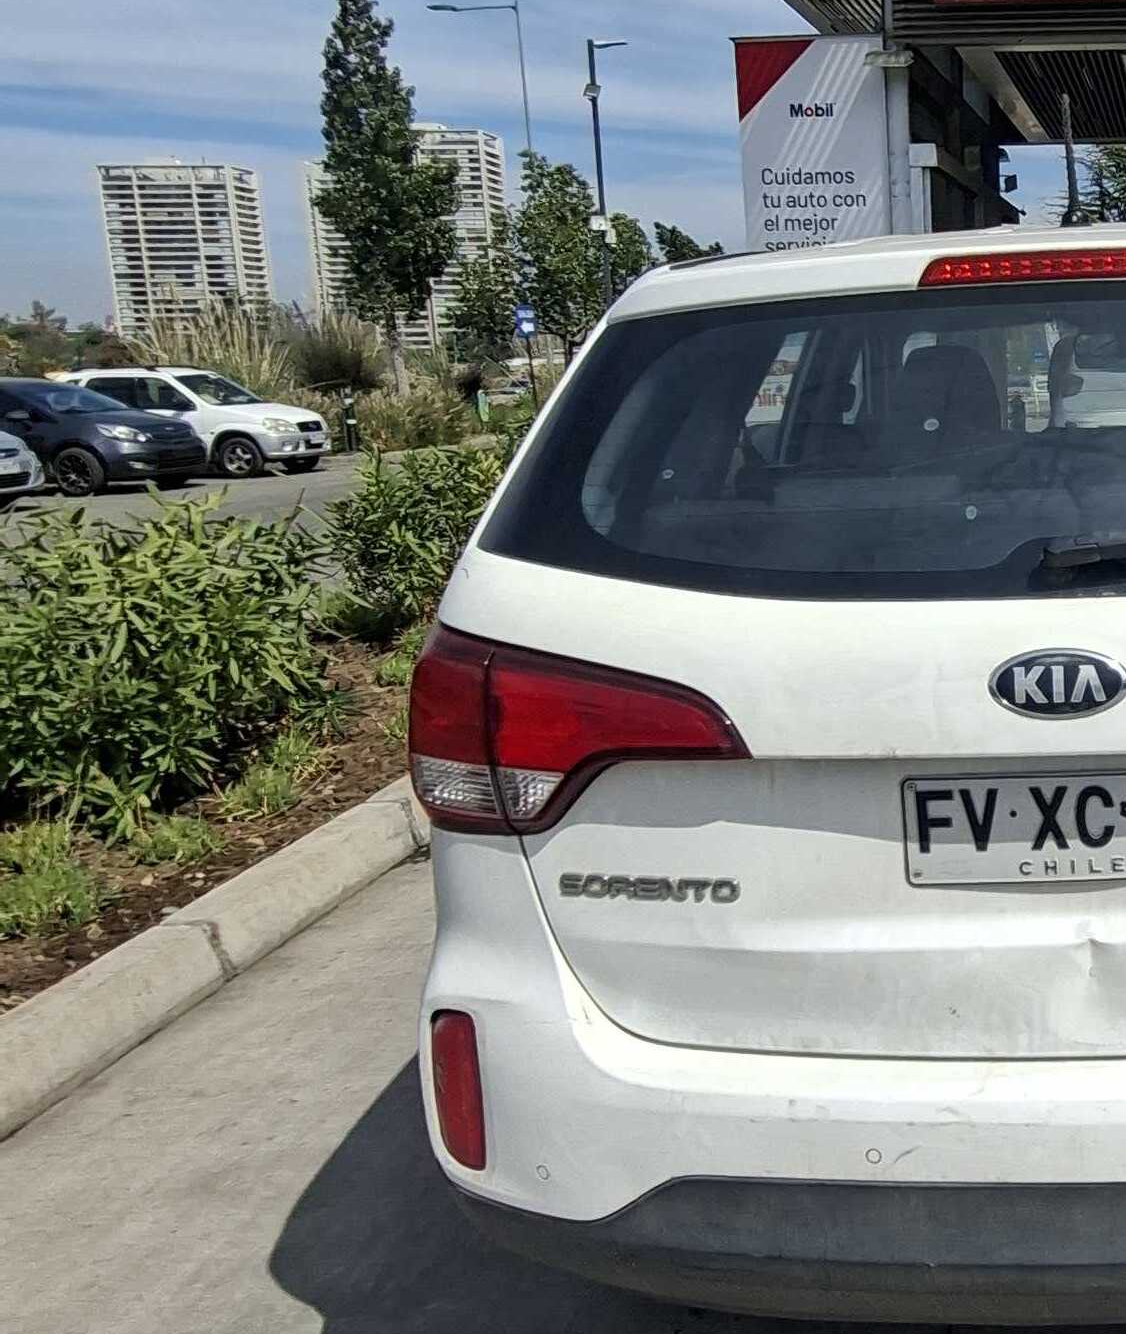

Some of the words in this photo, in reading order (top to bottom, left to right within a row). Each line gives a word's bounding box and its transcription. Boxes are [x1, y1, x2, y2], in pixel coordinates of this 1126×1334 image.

[790, 103, 834, 117] Mobil
[761, 167, 855, 185] Cuidamos
[763, 194, 781, 208] tu
[786, 194, 828, 208] auto
[832, 194, 867, 207] con
[764, 215, 779, 231] el
[784, 216, 838, 235] mejor
[765, 236, 836, 251] servii
[1012, 665, 1107, 705] KIA
[1019, 857, 1126, 876] CHILE
[559, 872, 741, 904] SORENTO
